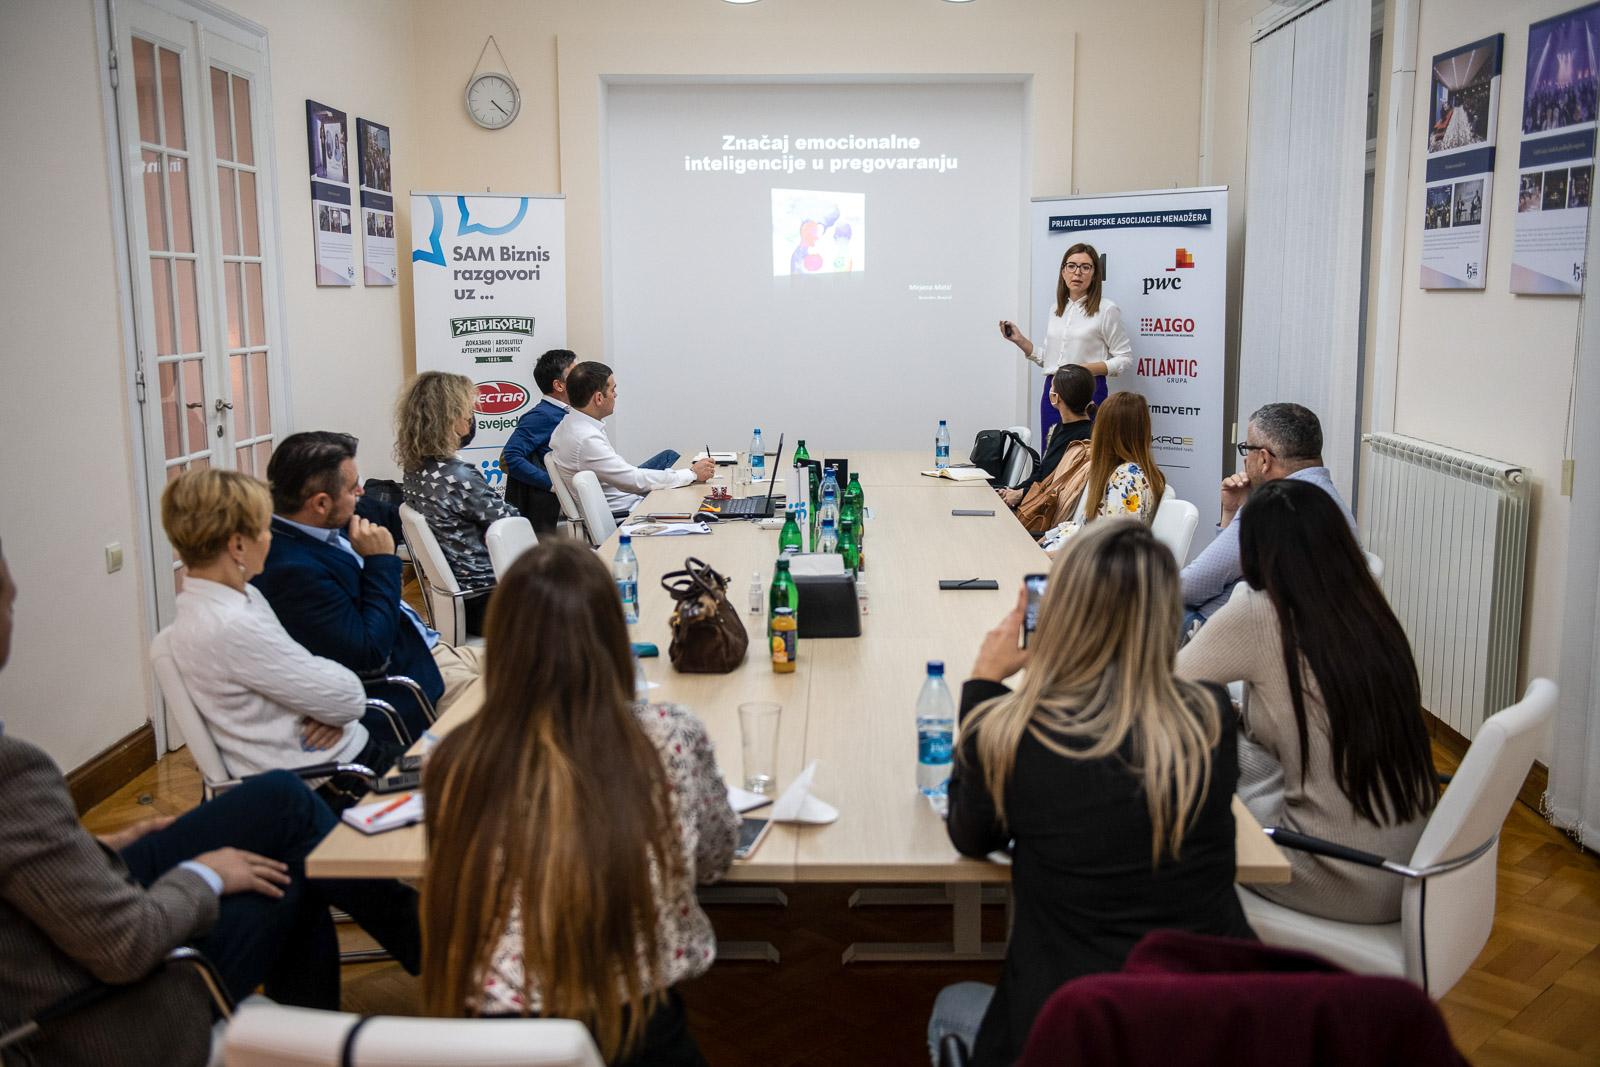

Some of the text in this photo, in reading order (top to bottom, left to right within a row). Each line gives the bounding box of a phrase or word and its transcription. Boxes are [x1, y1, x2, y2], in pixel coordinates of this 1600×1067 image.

[722, 134, 920, 153] Značaj emocionalne
[685, 154, 958, 174] inteligencije u pregovaranju
[1051, 212, 1208, 228] PRIJATELJI SRPSKE ASOCIJACIJE MENADŽERA
[453, 245, 550, 262] SAM Biznis
[453, 264, 540, 285] razgovori
[454, 289, 476, 300] uz
[1142, 277, 1182, 295] pwc
[1153, 318, 1195, 333] AIGO
[1137, 358, 1198, 377] ATLANTIC
[478, 416, 519, 431] svejed
[1151, 435, 1193, 446] KROE
